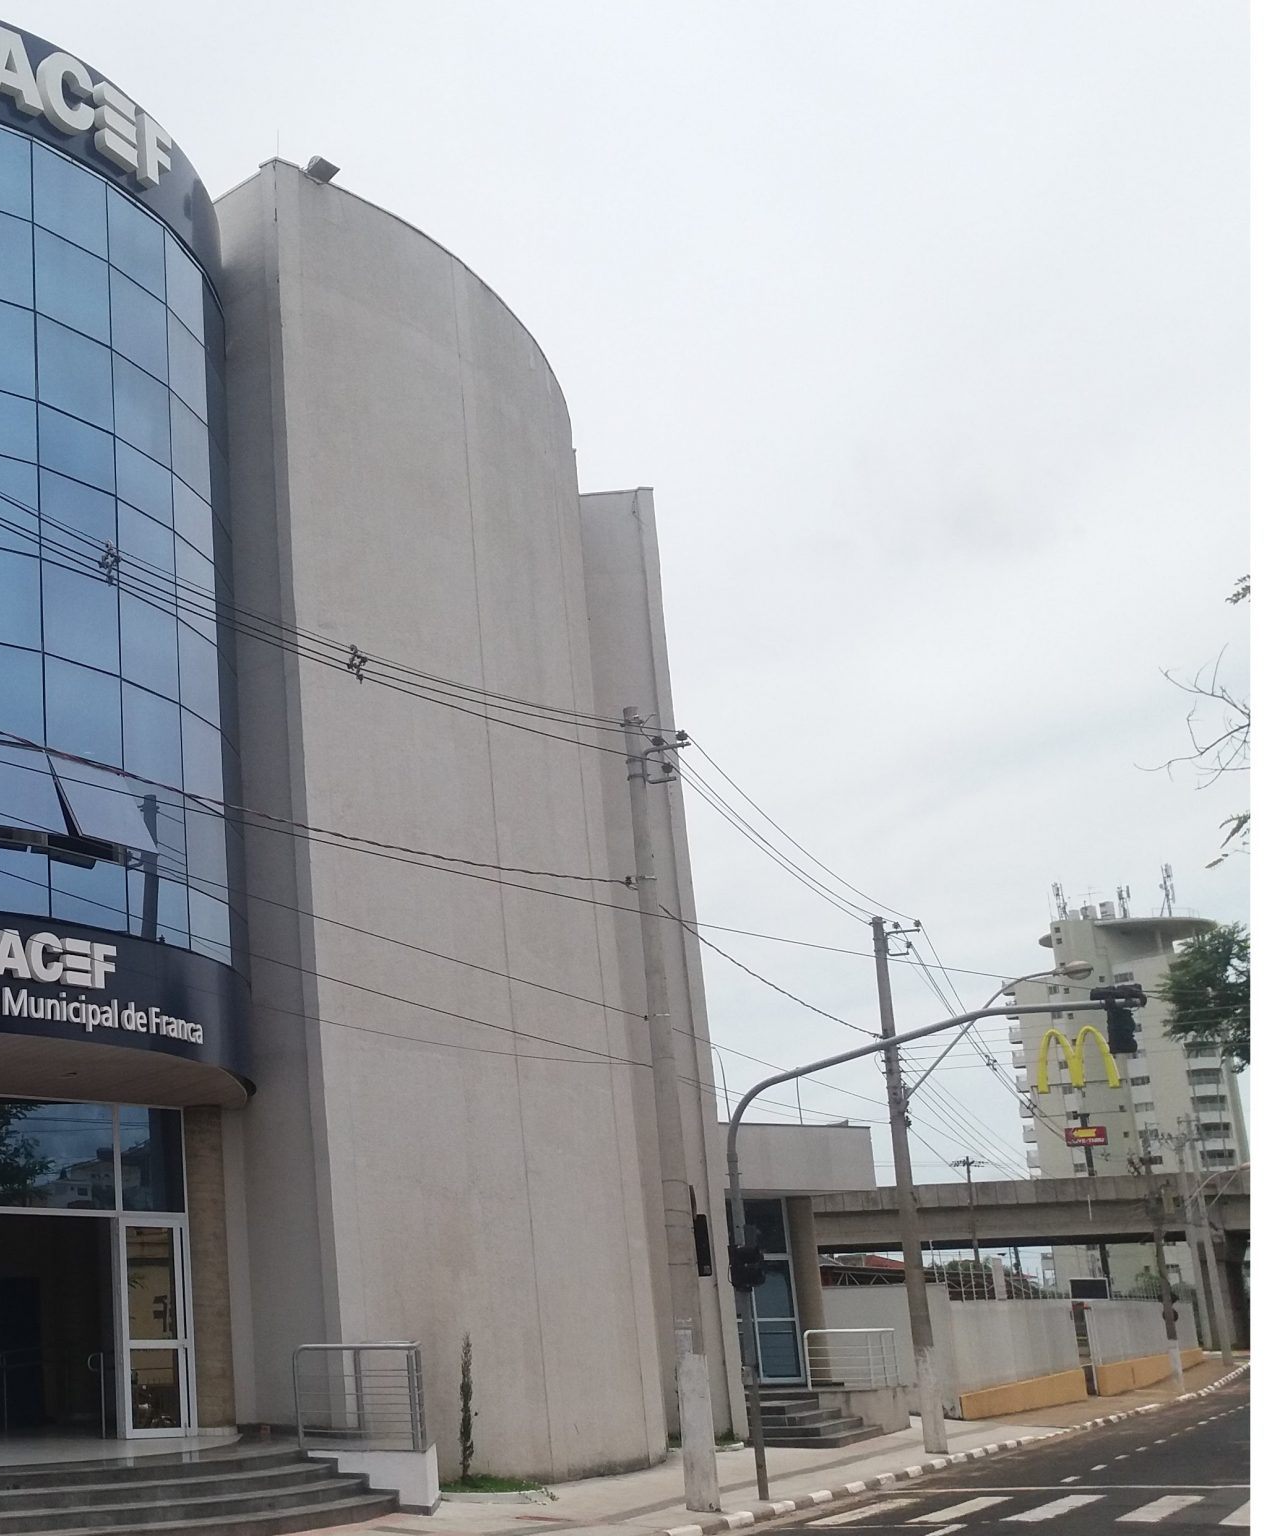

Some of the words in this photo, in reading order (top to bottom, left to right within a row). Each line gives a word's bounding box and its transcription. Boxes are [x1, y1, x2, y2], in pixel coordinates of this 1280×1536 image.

[3, 987, 118, 1032] Municipal
[122, 1002, 148, 1033] de
[149, 1006, 204, 1044] Franca
